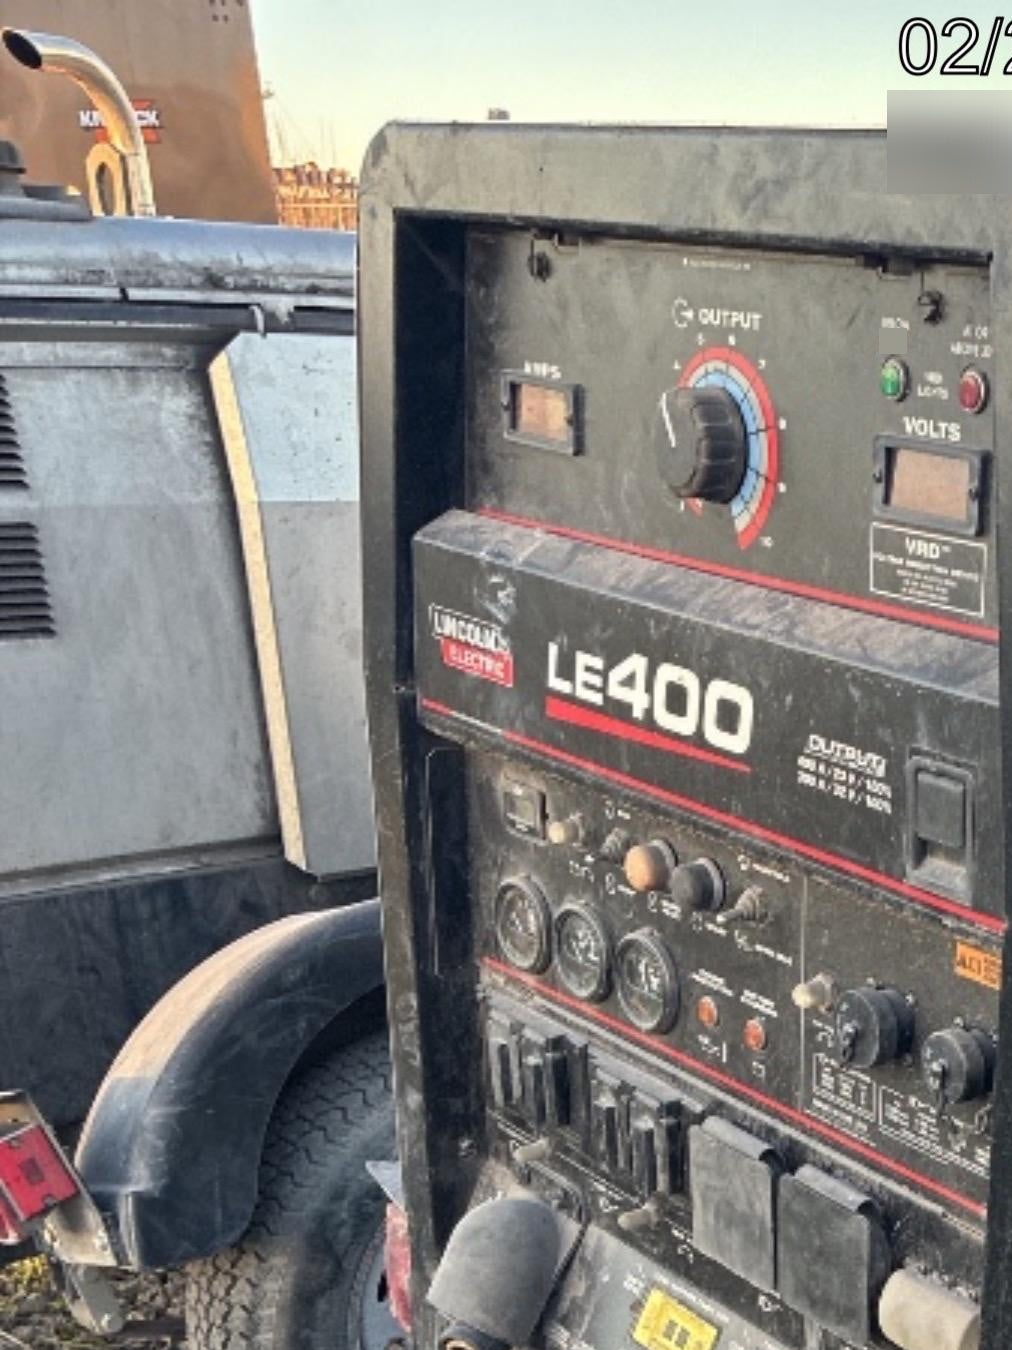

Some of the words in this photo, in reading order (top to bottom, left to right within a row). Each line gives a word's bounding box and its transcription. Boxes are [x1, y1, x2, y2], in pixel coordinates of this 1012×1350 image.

[698, 308, 762, 331] OUTPUT
[903, 416, 961, 442] VOLTS
[547, 641, 754, 754] LE400
